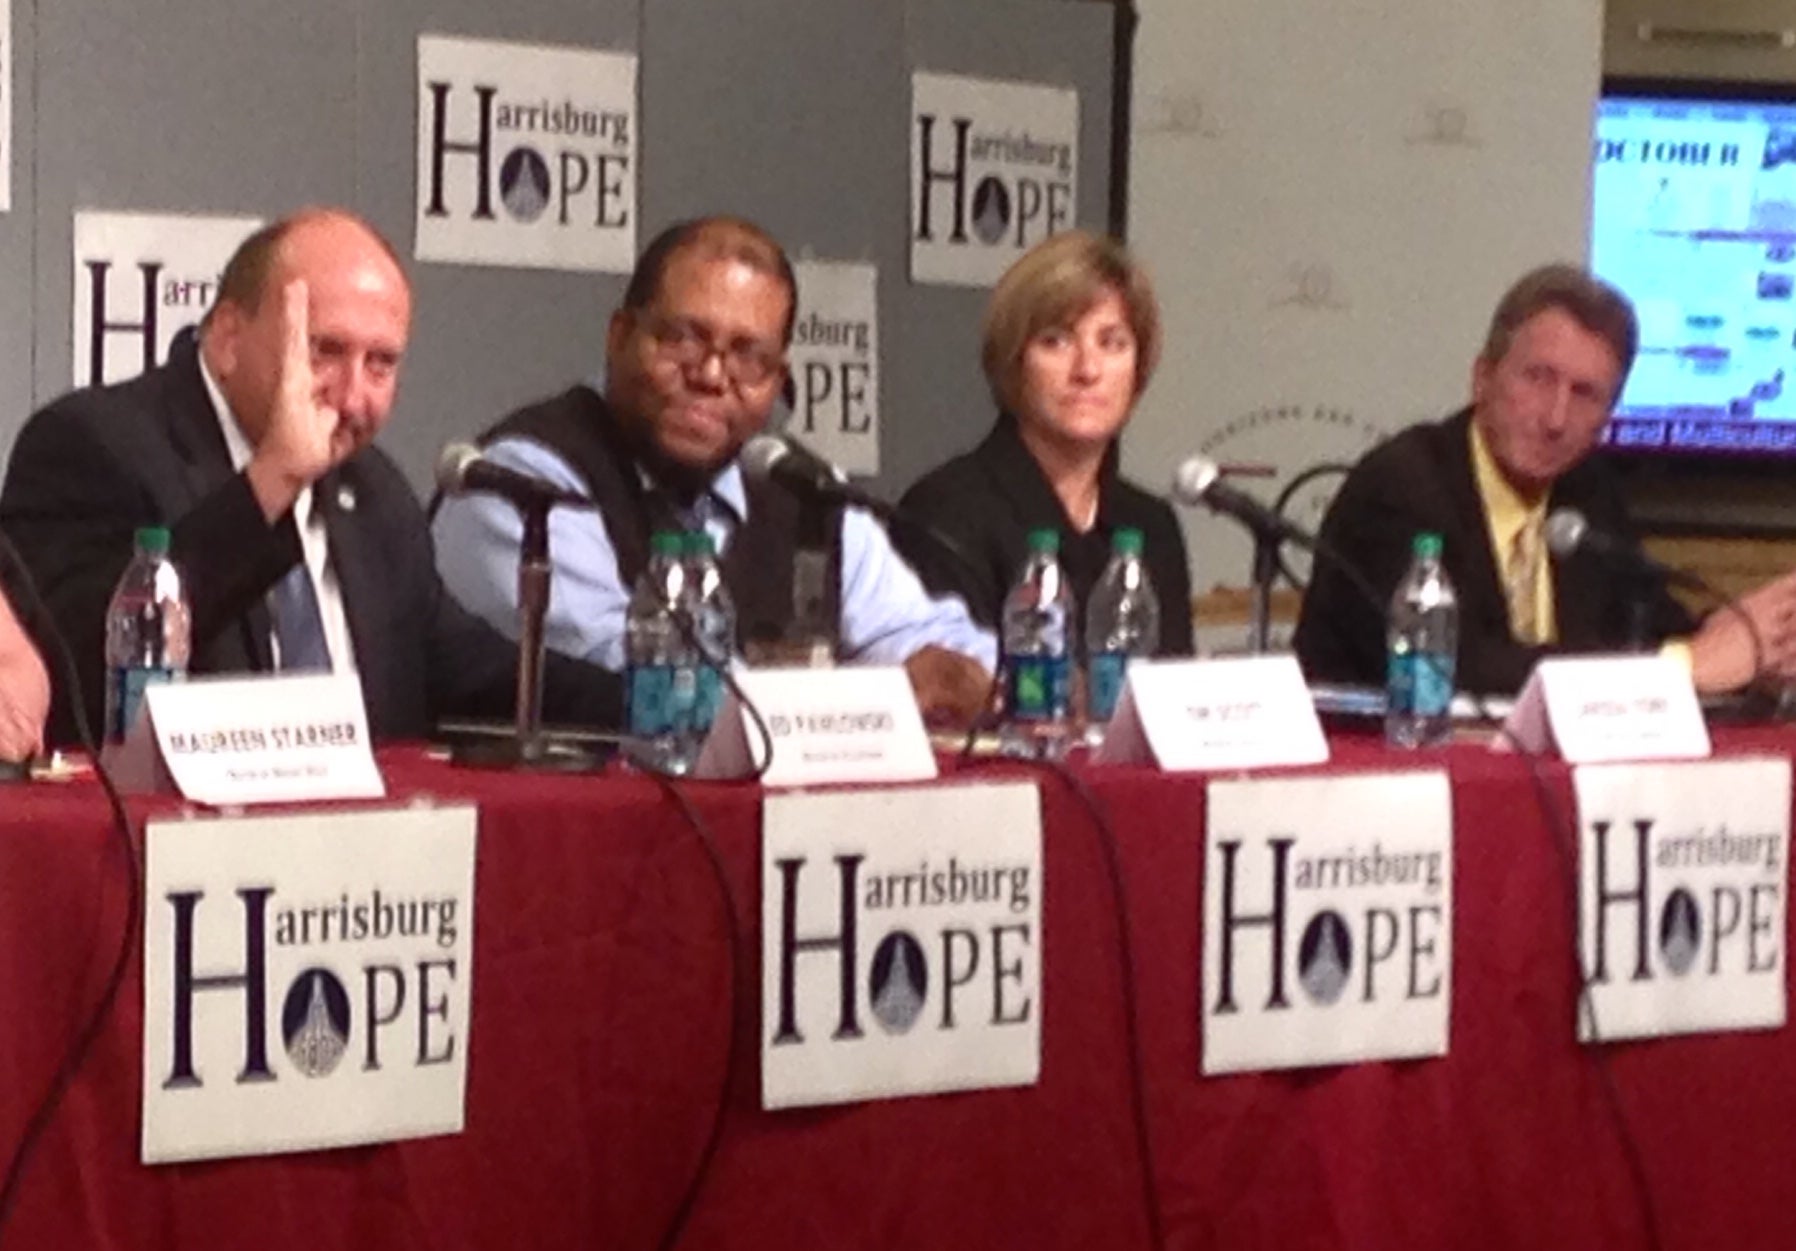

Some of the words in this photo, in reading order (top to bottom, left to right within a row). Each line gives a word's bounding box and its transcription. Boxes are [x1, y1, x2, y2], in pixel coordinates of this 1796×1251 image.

[798, 312, 869, 355] sburg
[170, 730, 267, 754] MAUREEN
[271, 722, 358, 748] STARNER
